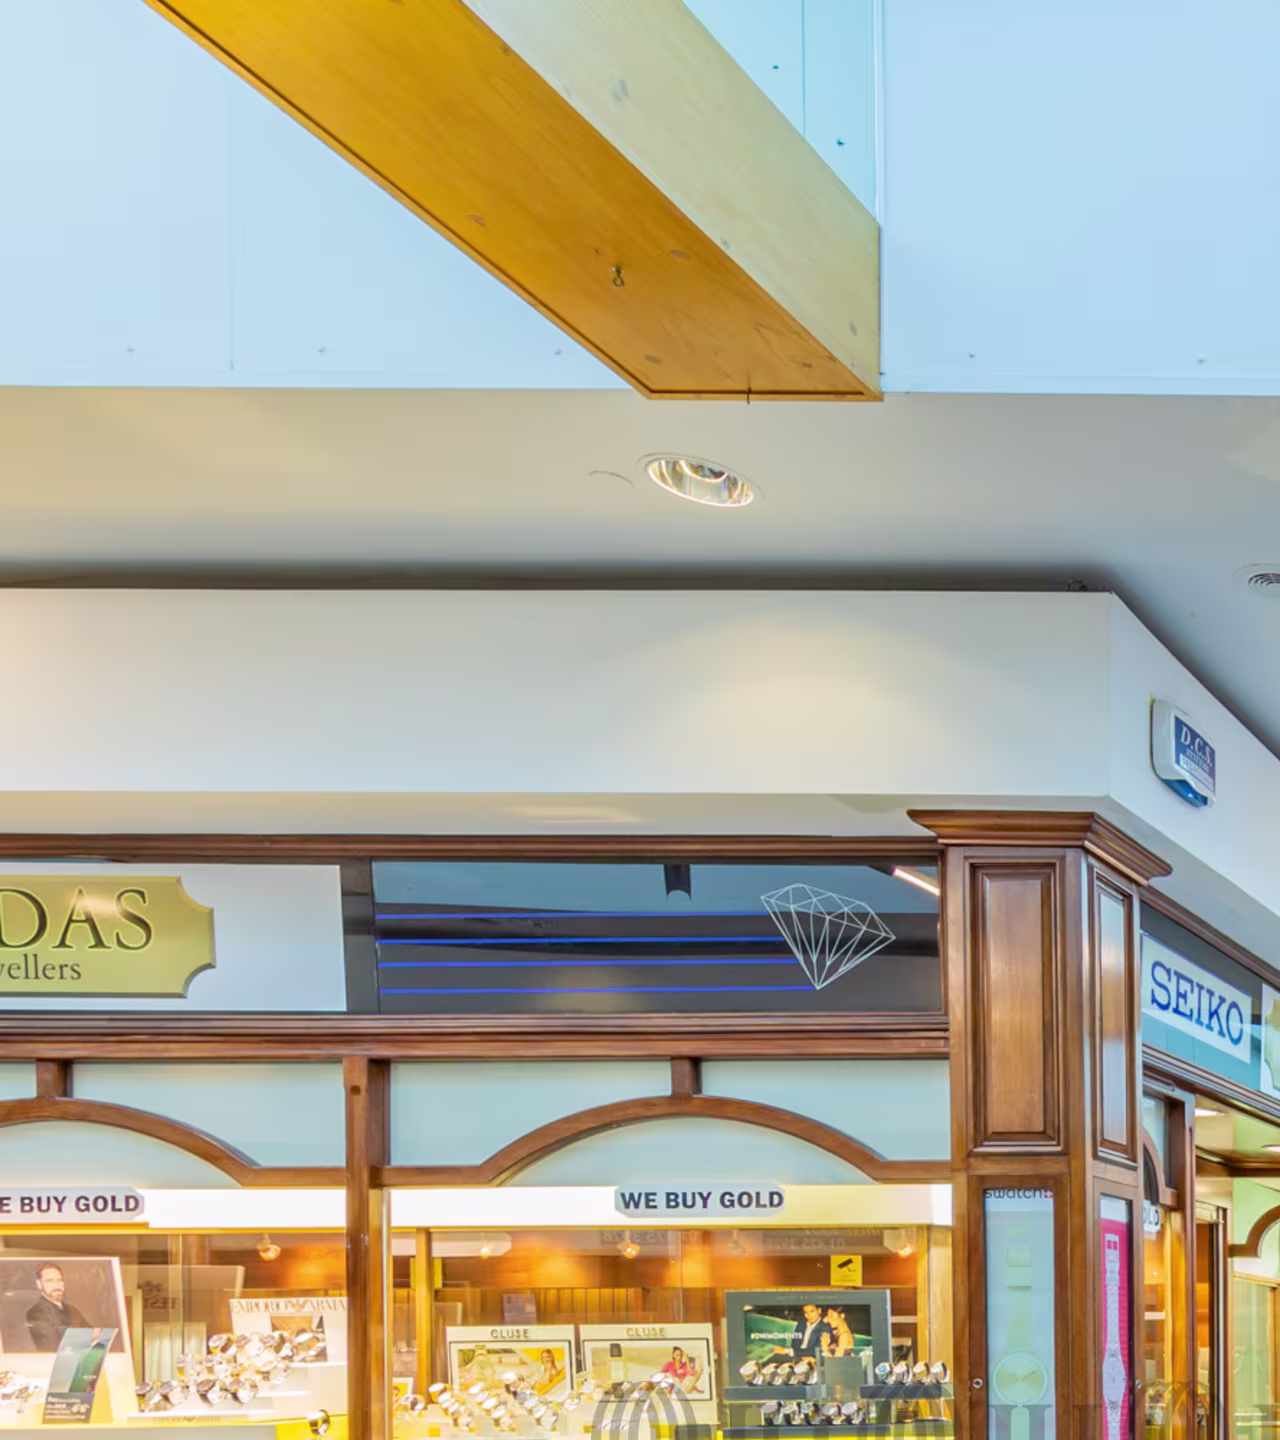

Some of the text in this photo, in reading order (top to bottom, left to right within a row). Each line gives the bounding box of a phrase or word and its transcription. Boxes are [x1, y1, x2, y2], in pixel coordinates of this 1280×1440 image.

[1150, 960, 1244, 1047] SEIKO
[20, 1196, 67, 1213] BUY
[74, 1195, 140, 1213] GOLD
[620, 1191, 785, 1209] WE BUY GOLD
[490, 1329, 530, 1339] CLUSE
[626, 1327, 666, 1338] CLUSE
